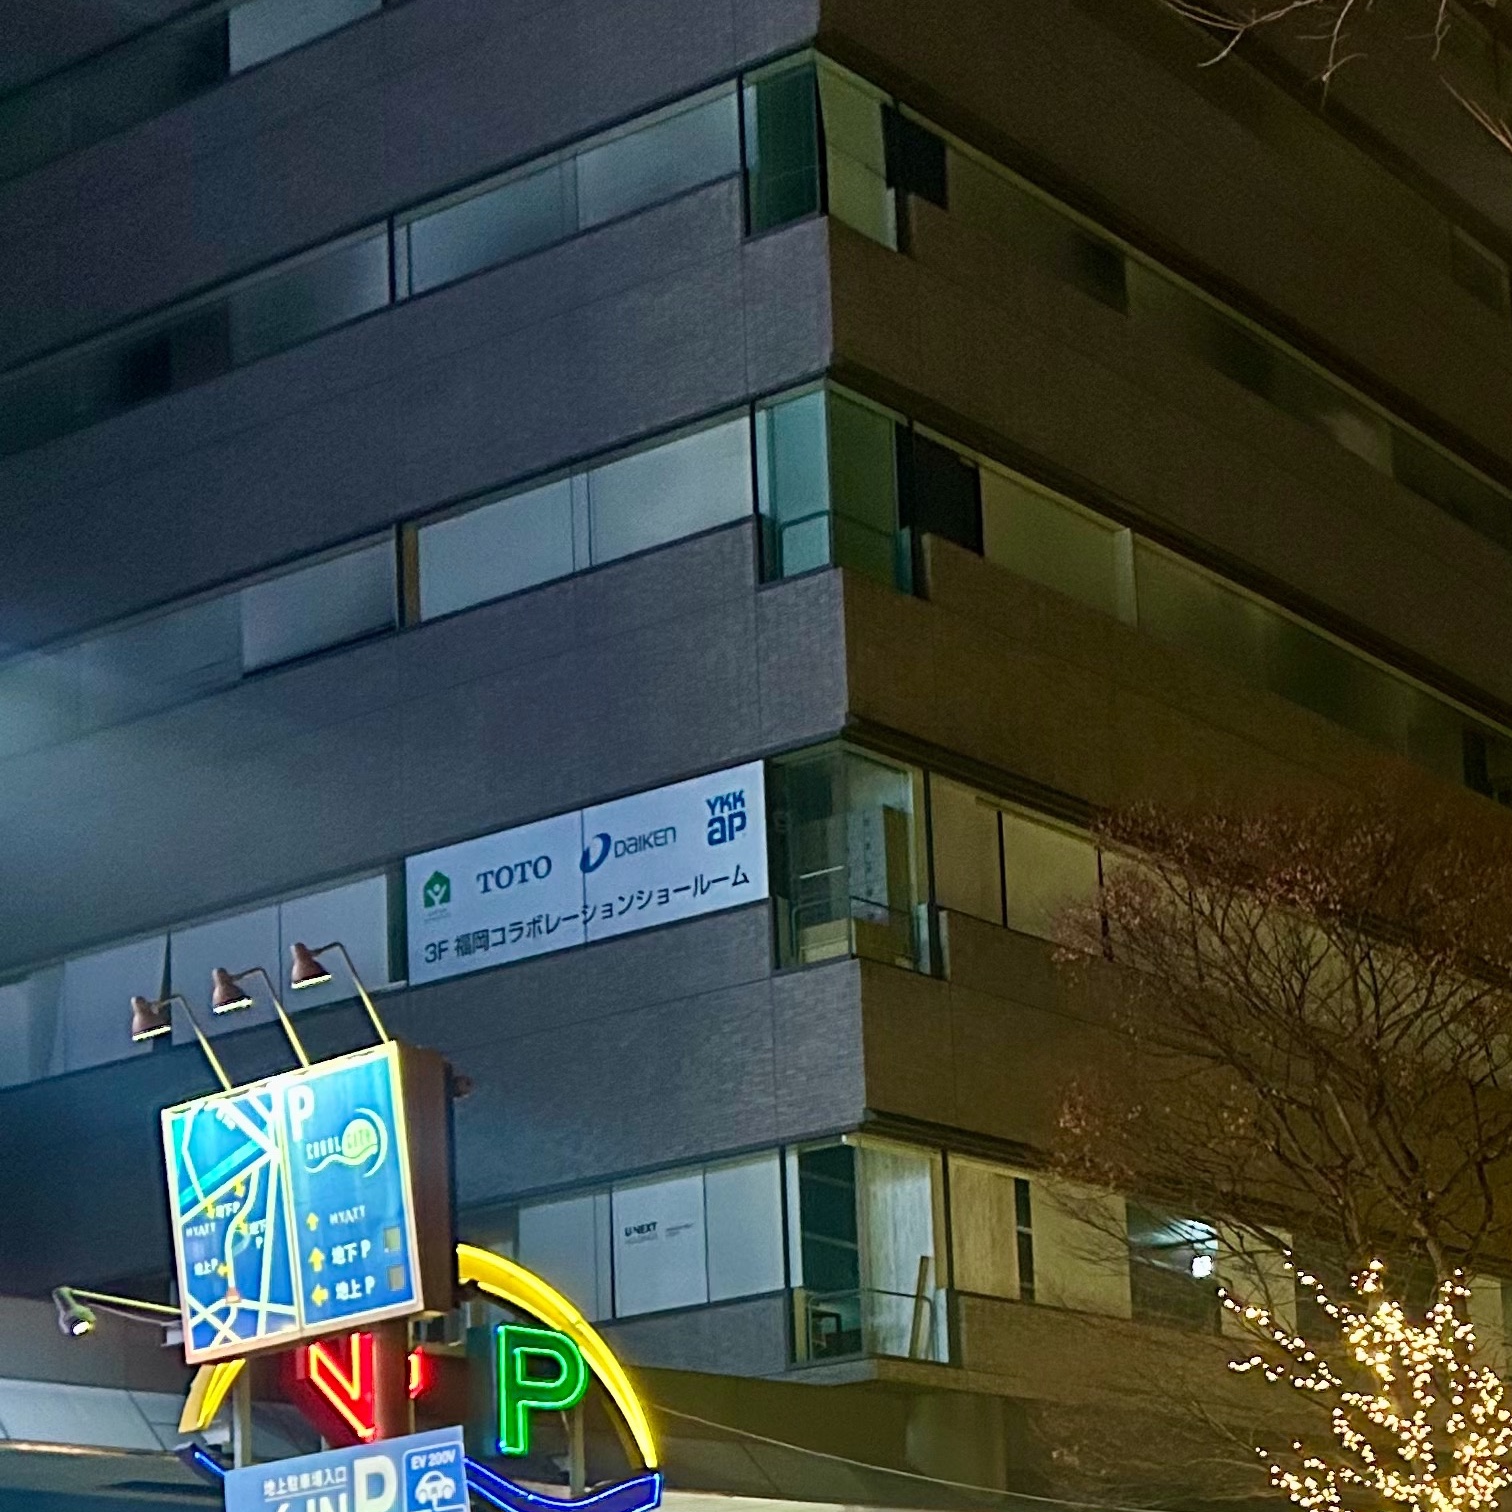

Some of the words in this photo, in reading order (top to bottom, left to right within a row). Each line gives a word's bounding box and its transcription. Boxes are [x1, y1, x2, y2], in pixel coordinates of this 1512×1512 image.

[706, 789, 746, 816] YKK
[476, 855, 553, 894] TOTO
[424, 939, 449, 964] 3F
[454, 864, 750, 957] 福岡コラボレーションショールーム
[287, 1084, 315, 1142] P
[360, 1239, 372, 1259] P
[364, 1274, 376, 1294] P
[497, 1323, 590, 1456] P
[411, 1454, 426, 1471] EV
